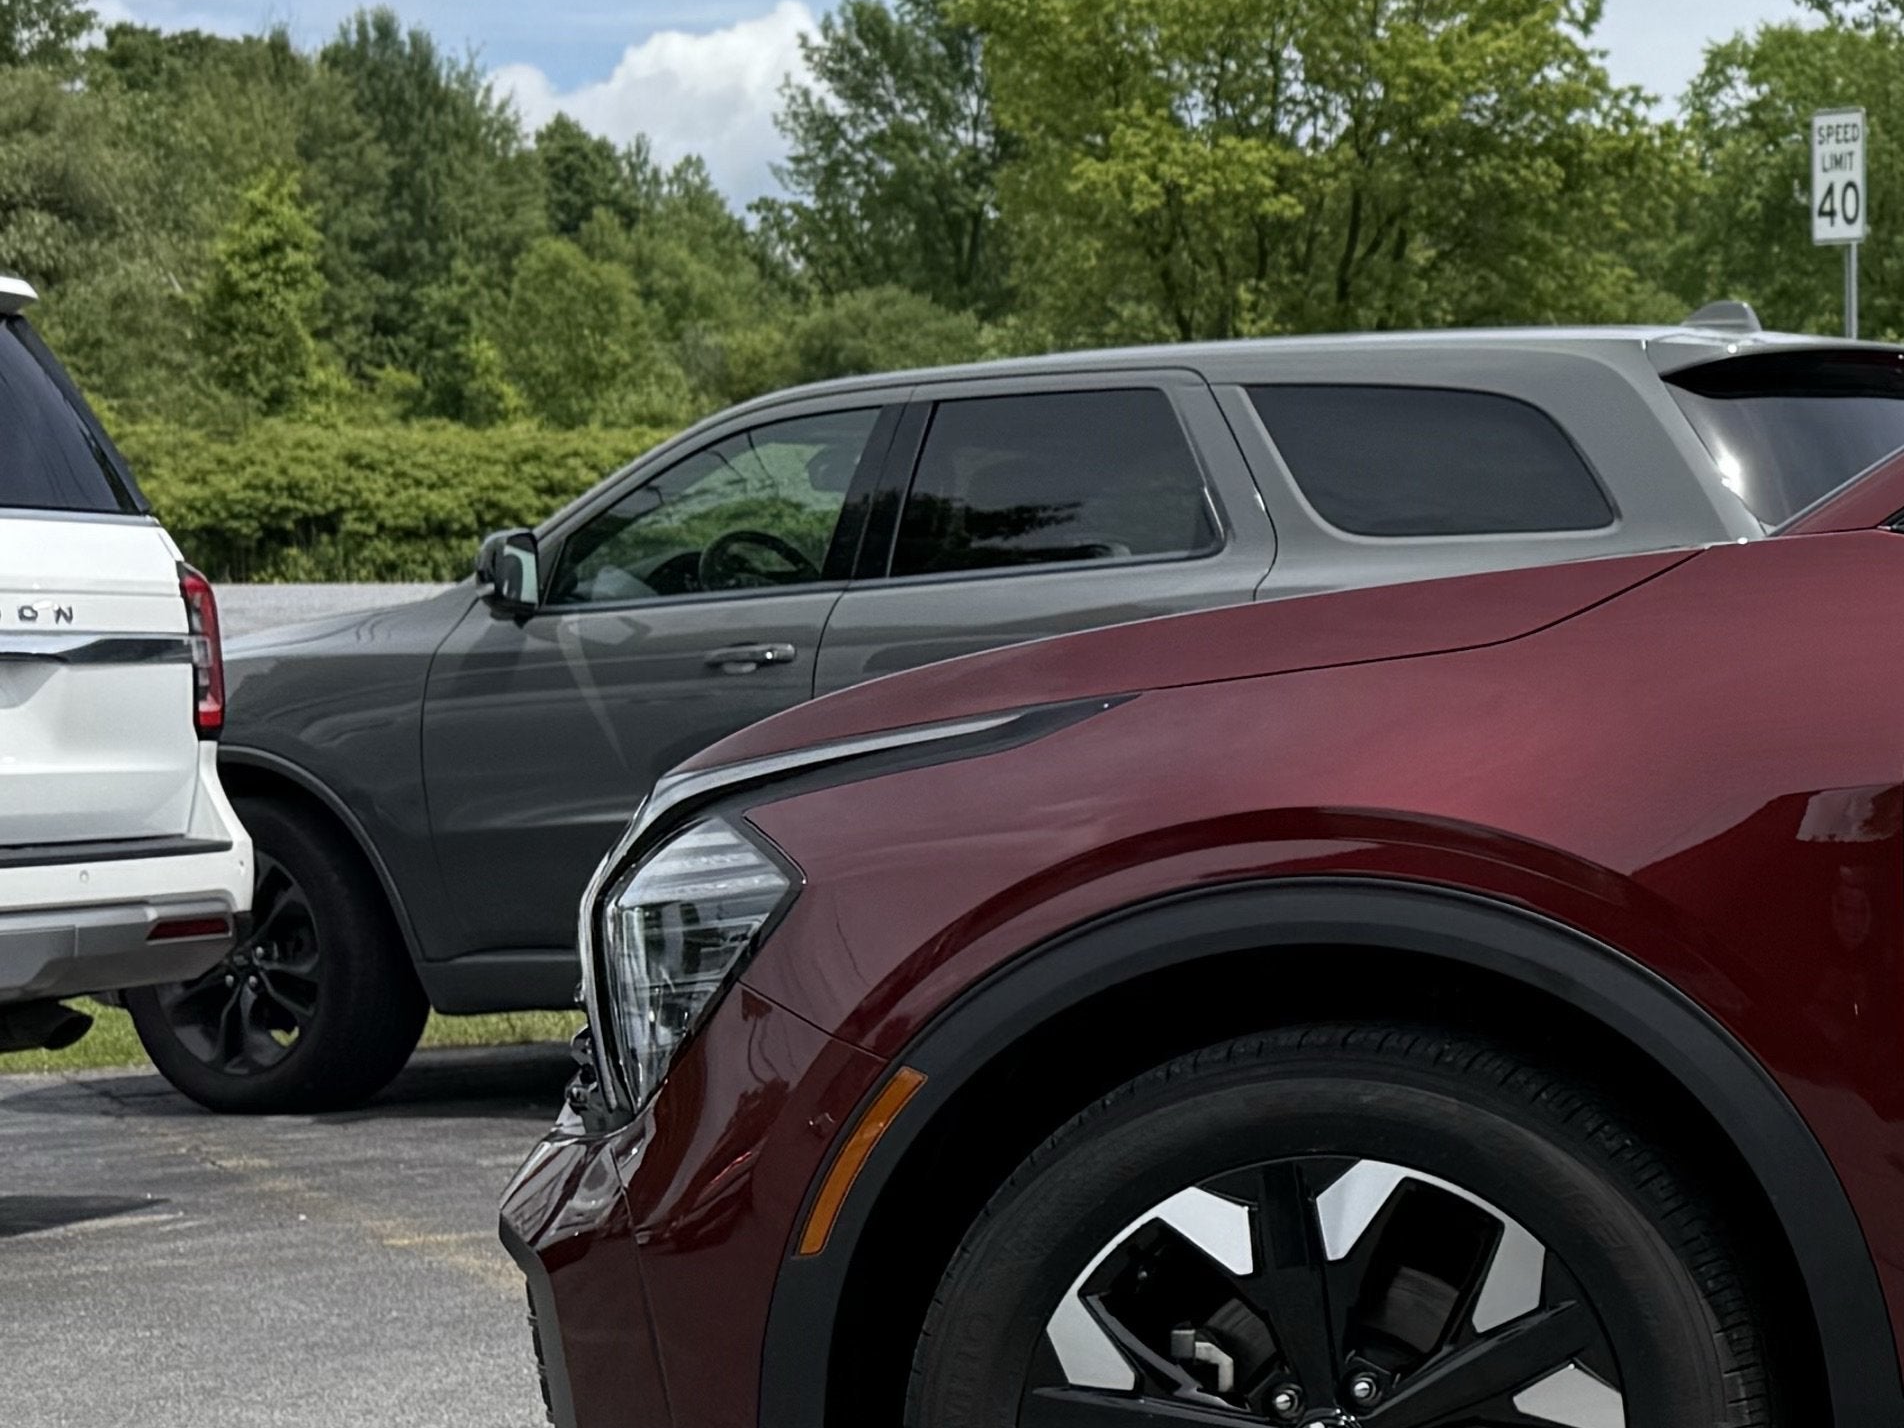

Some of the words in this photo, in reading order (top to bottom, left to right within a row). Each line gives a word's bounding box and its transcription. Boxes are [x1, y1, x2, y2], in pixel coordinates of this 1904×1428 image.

[1818, 123, 1859, 145] SPEED
[1822, 151, 1854, 173] LIMIT
[1818, 180, 1859, 228] 40
[0, 604, 74, 624] ON
